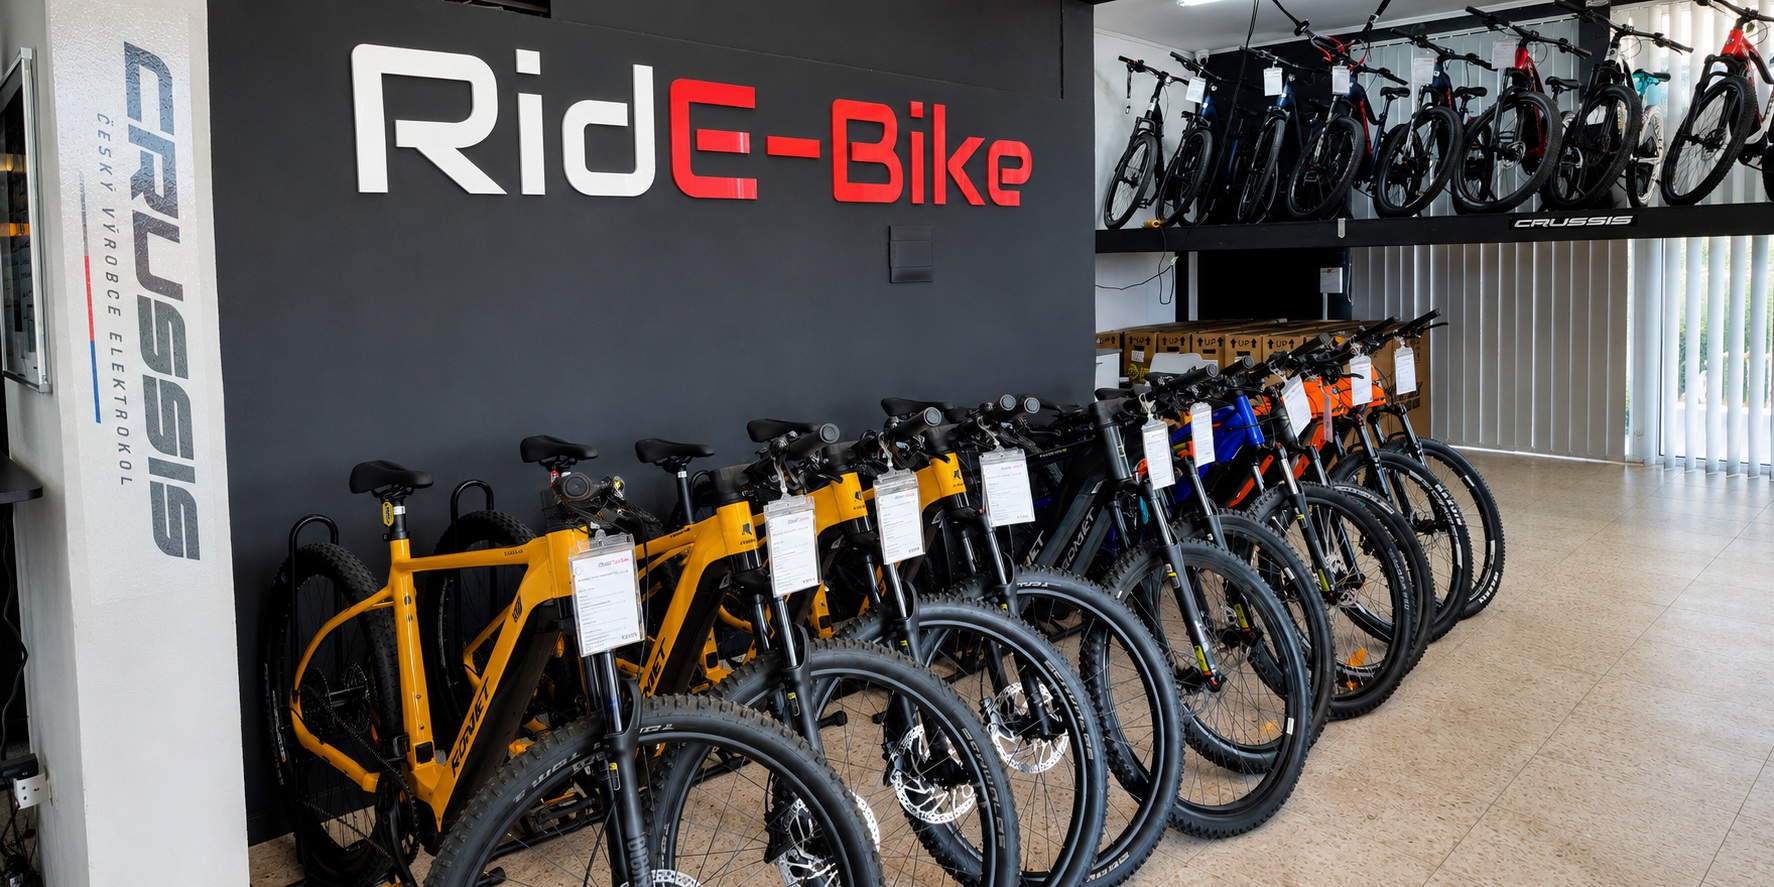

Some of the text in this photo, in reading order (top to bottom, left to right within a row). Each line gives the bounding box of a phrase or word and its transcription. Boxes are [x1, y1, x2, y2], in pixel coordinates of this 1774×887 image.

[351, 43, 1033, 207] RidE-Bike
[1514, 215, 1633, 228] CRUSSIS
[97, 113, 133, 486] ČESKÝ VÝROBCE ELEKTROKOL
[122, 40, 201, 561] CRUSSIS
[1204, 338, 1216, 346] UP
[1237, 339, 1250, 347] UP
[1275, 340, 1288, 348] UP
